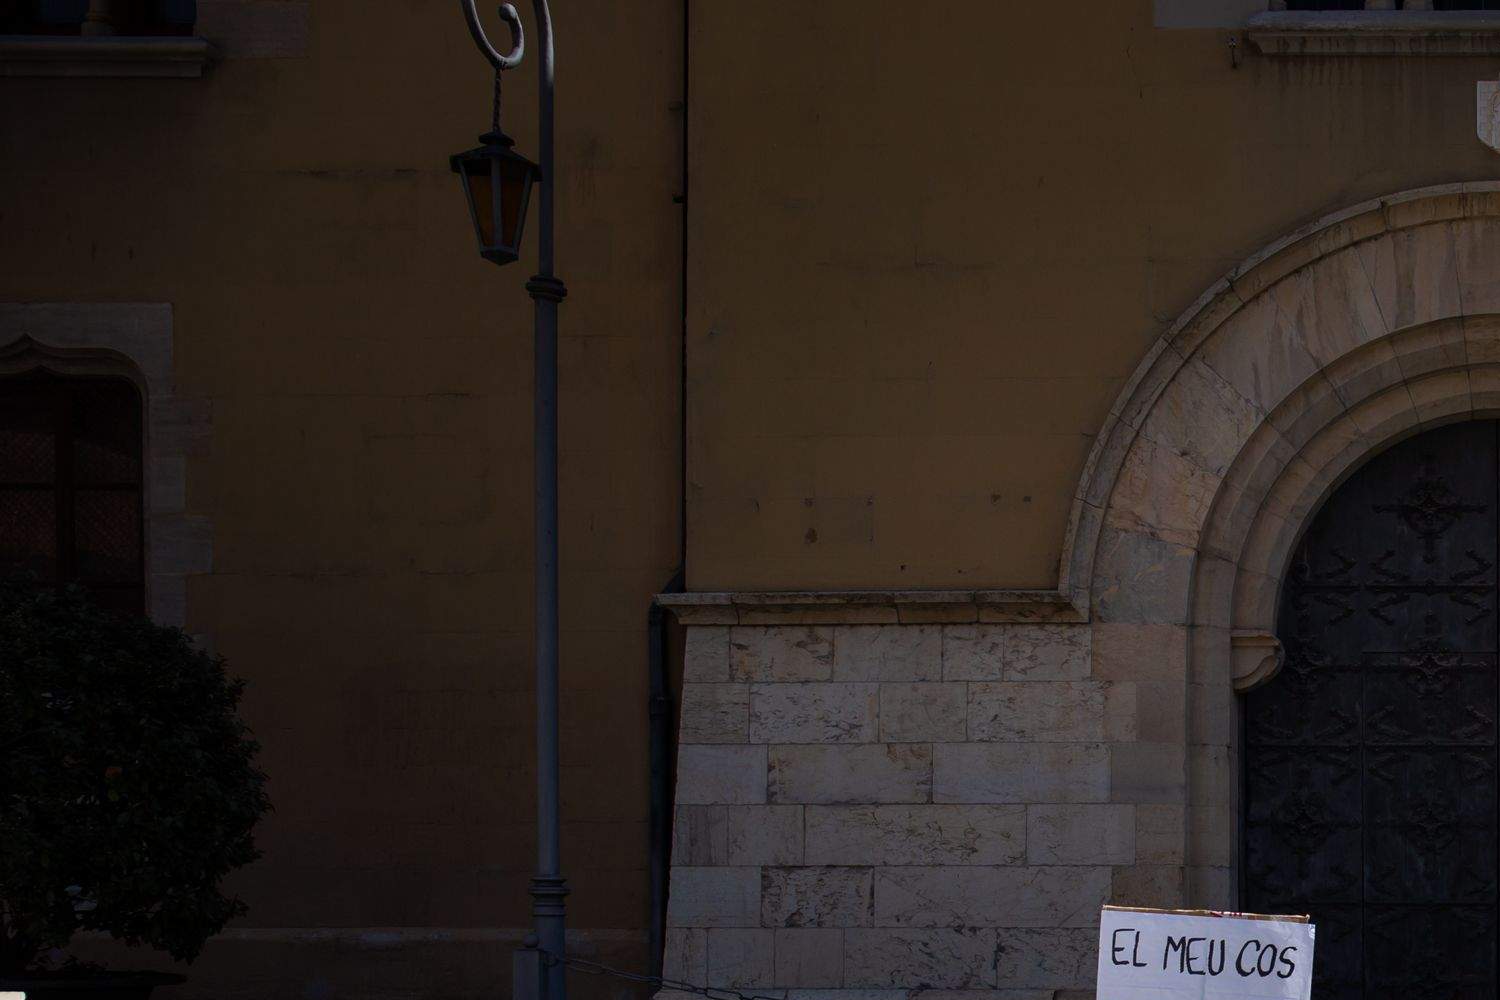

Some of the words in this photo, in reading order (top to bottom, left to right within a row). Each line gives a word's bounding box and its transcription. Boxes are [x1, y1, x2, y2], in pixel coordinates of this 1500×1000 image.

[1111, 928, 1147, 967] EL
[1163, 935, 1226, 976] MEU
[1235, 939, 1298, 979] COS
